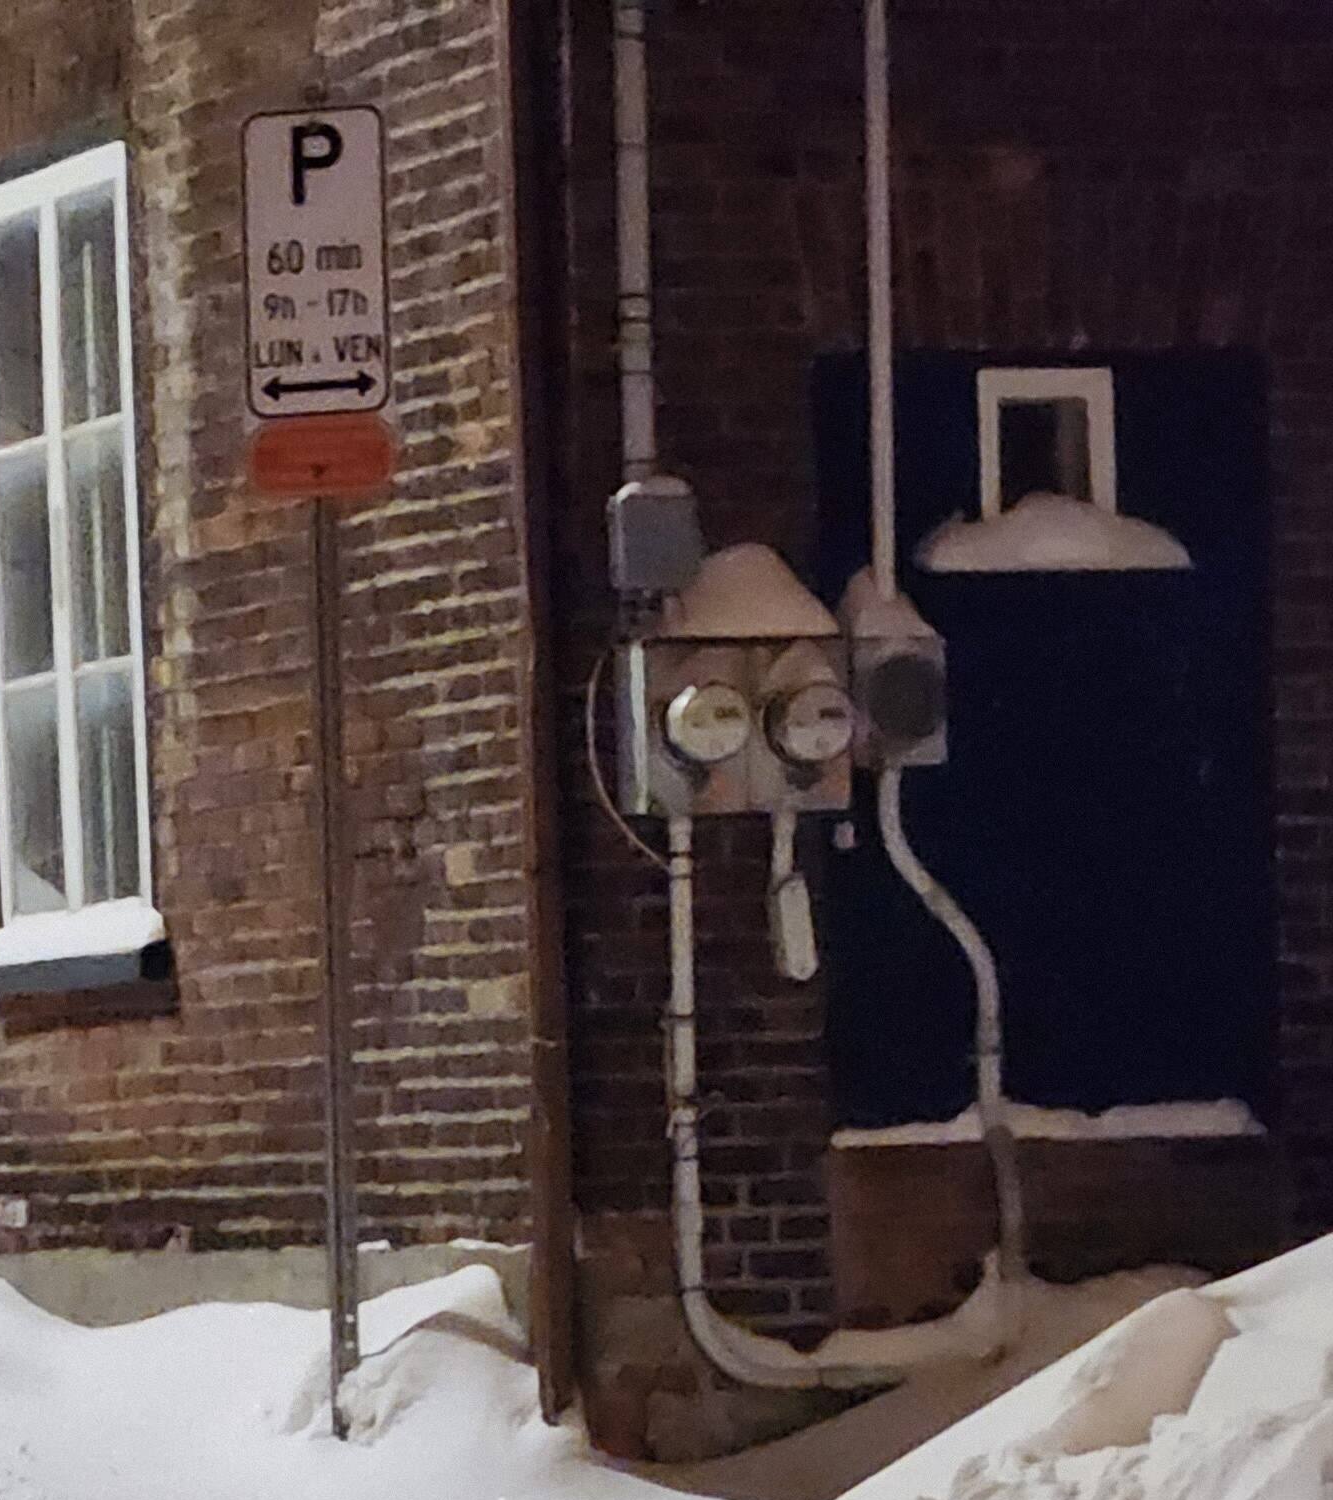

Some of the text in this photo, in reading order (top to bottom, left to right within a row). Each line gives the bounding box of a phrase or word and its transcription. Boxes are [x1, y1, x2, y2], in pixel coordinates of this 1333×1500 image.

[291, 123, 344, 206] P
[267, 239, 362, 275] 60 min
[253, 339, 303, 368] LUN
[333, 333, 382, 363] VEN
